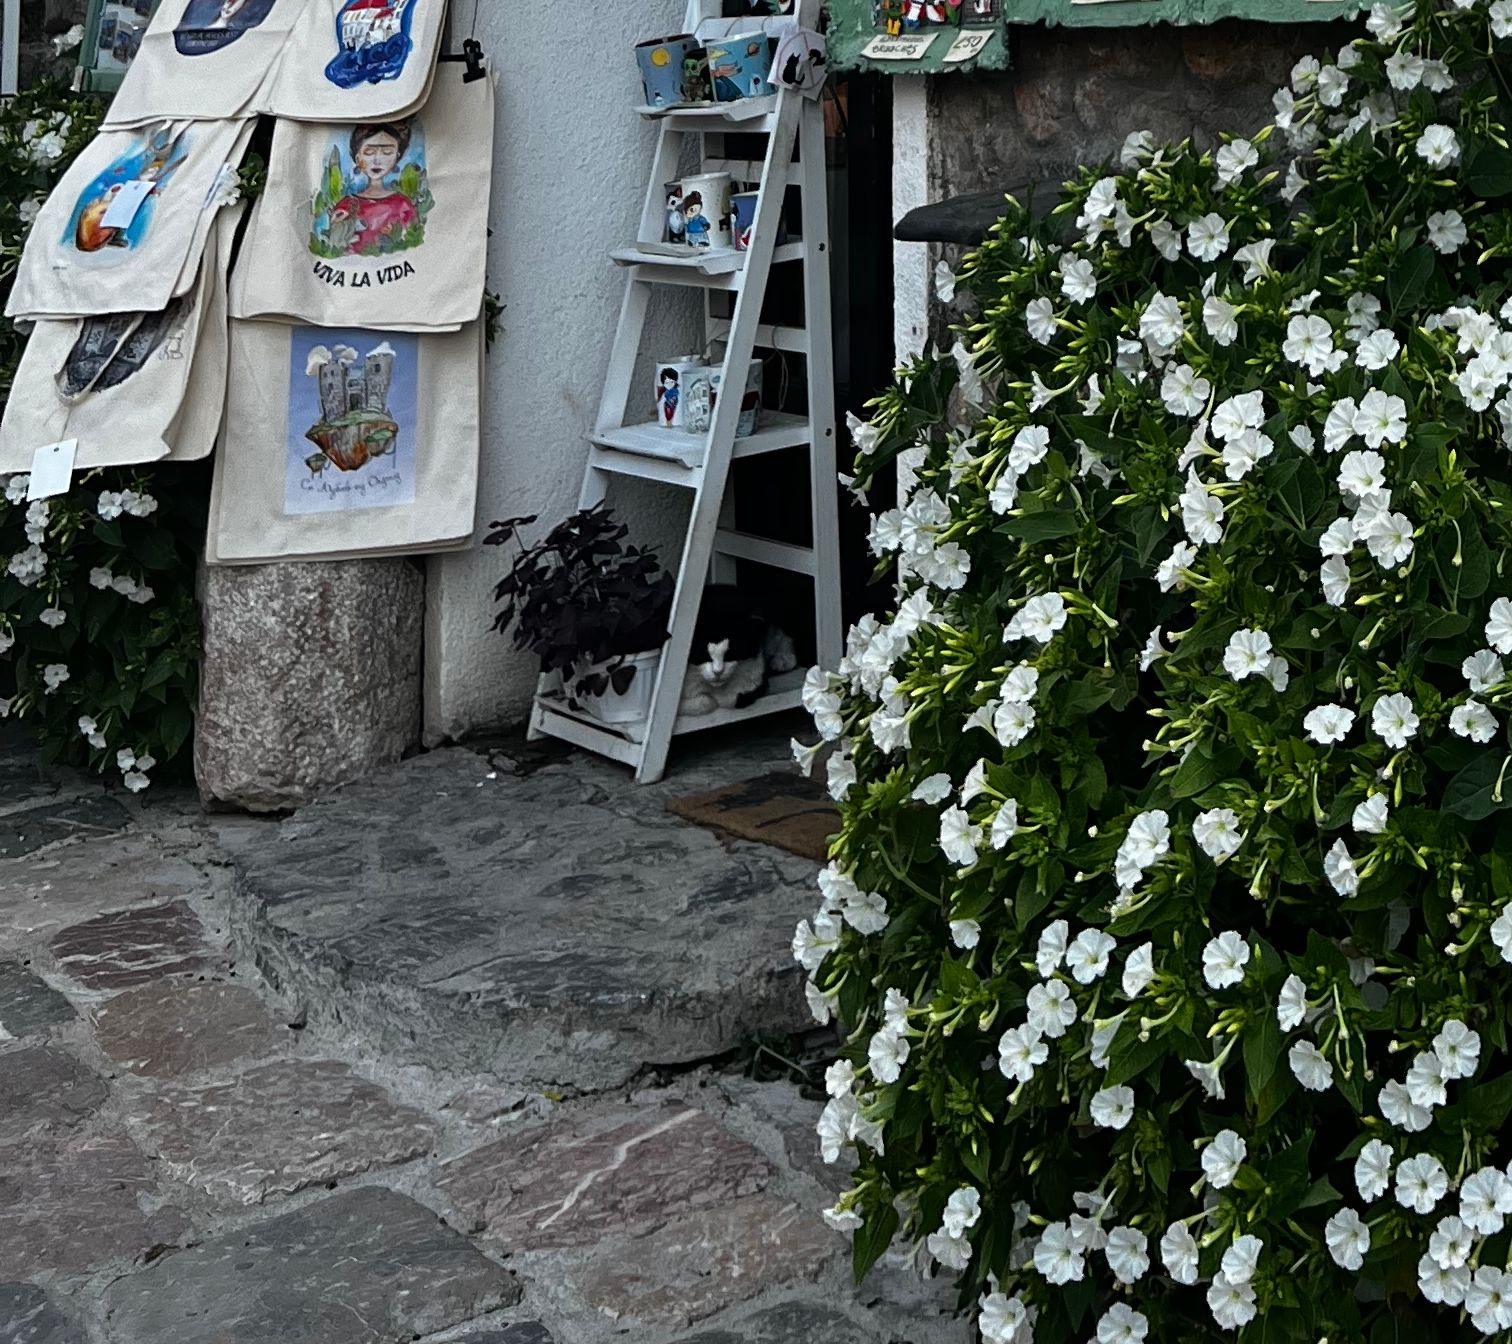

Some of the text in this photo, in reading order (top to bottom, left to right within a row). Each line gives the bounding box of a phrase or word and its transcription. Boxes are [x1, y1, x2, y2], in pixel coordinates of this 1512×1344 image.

[313, 260, 416, 288] VIVA LA VIDA
